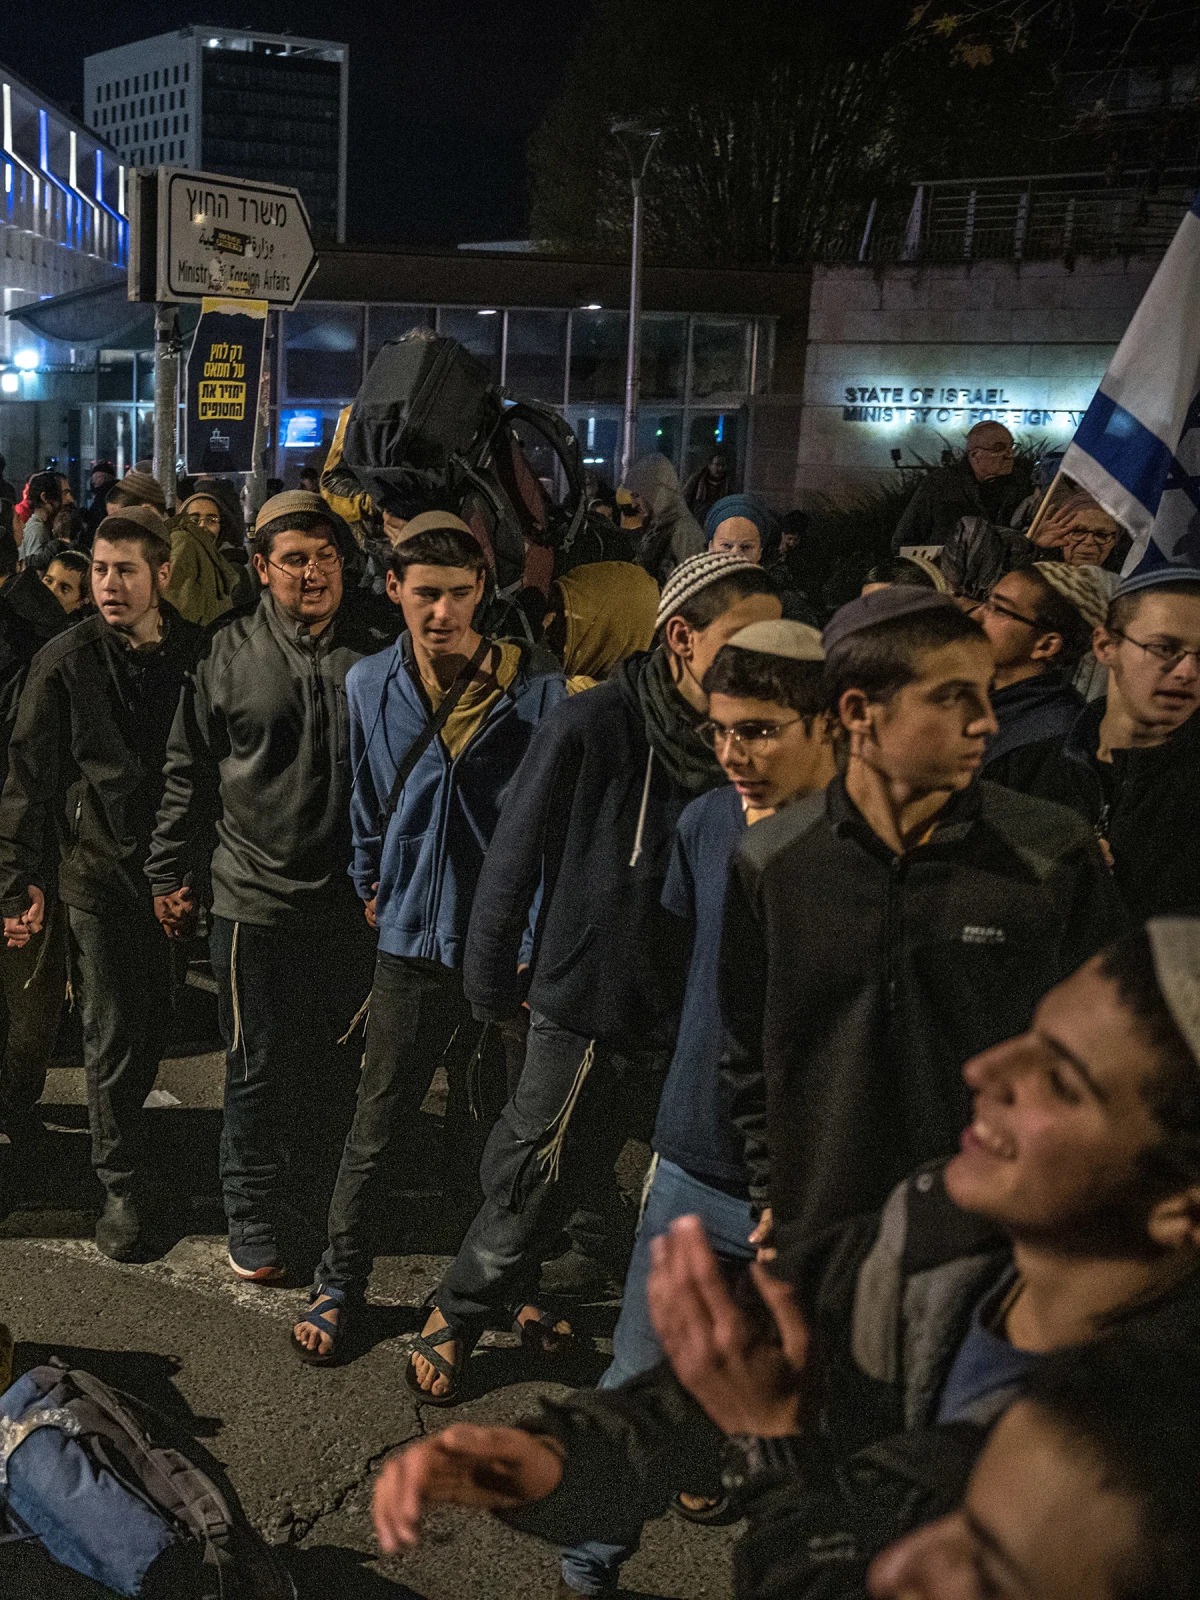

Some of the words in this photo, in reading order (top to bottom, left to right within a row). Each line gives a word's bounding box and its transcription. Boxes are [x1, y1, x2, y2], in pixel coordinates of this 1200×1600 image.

[186, 188, 228, 221] החוץ
[238, 197, 287, 227] משרד
[210, 343, 228, 361] לחץ
[231, 346, 242, 361] רק
[204, 363, 230, 377] חמאס
[233, 361, 244, 378] על
[202, 384, 217, 398] את
[219, 385, 243, 398] יחזיר
[844, 387, 904, 403] STATE
[910, 387, 933, 403] OF
[941, 388, 1010, 403] ISRAEL
[202, 403, 242, 416] החטופים
